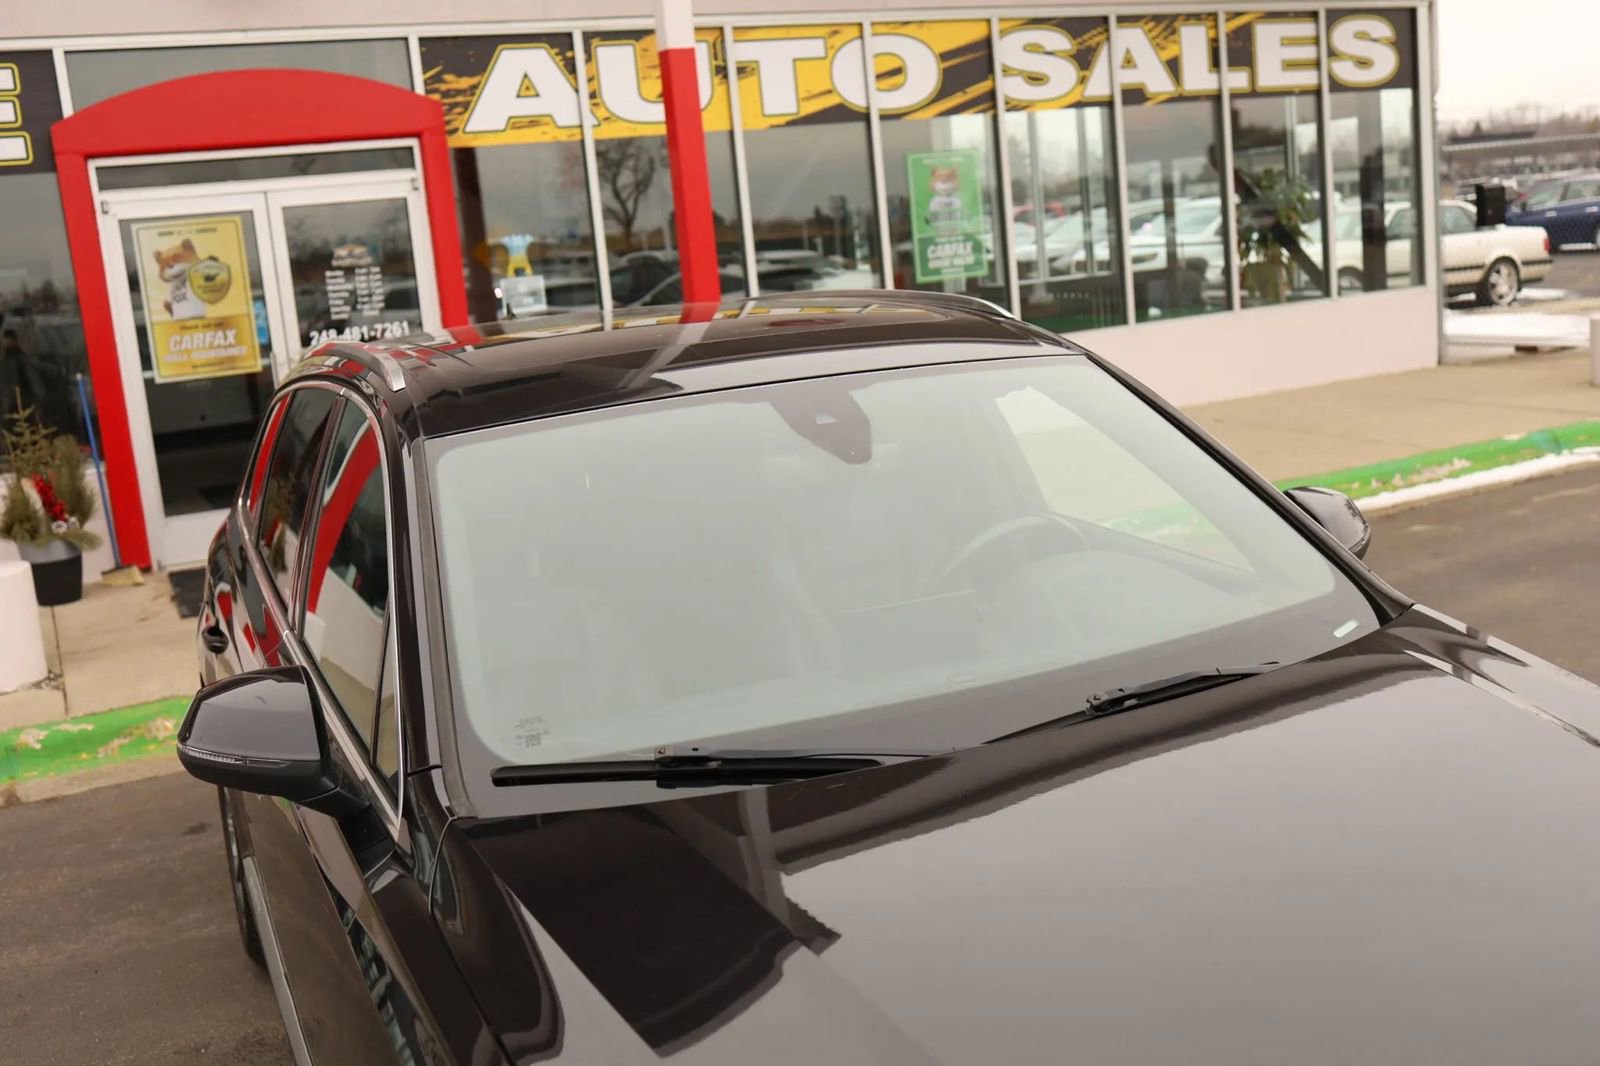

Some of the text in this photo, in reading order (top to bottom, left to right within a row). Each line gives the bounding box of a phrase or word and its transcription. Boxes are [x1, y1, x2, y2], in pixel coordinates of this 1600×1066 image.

[463, 14, 1400, 134] AUTO SALES
[169, 328, 237, 352] CARFAX
